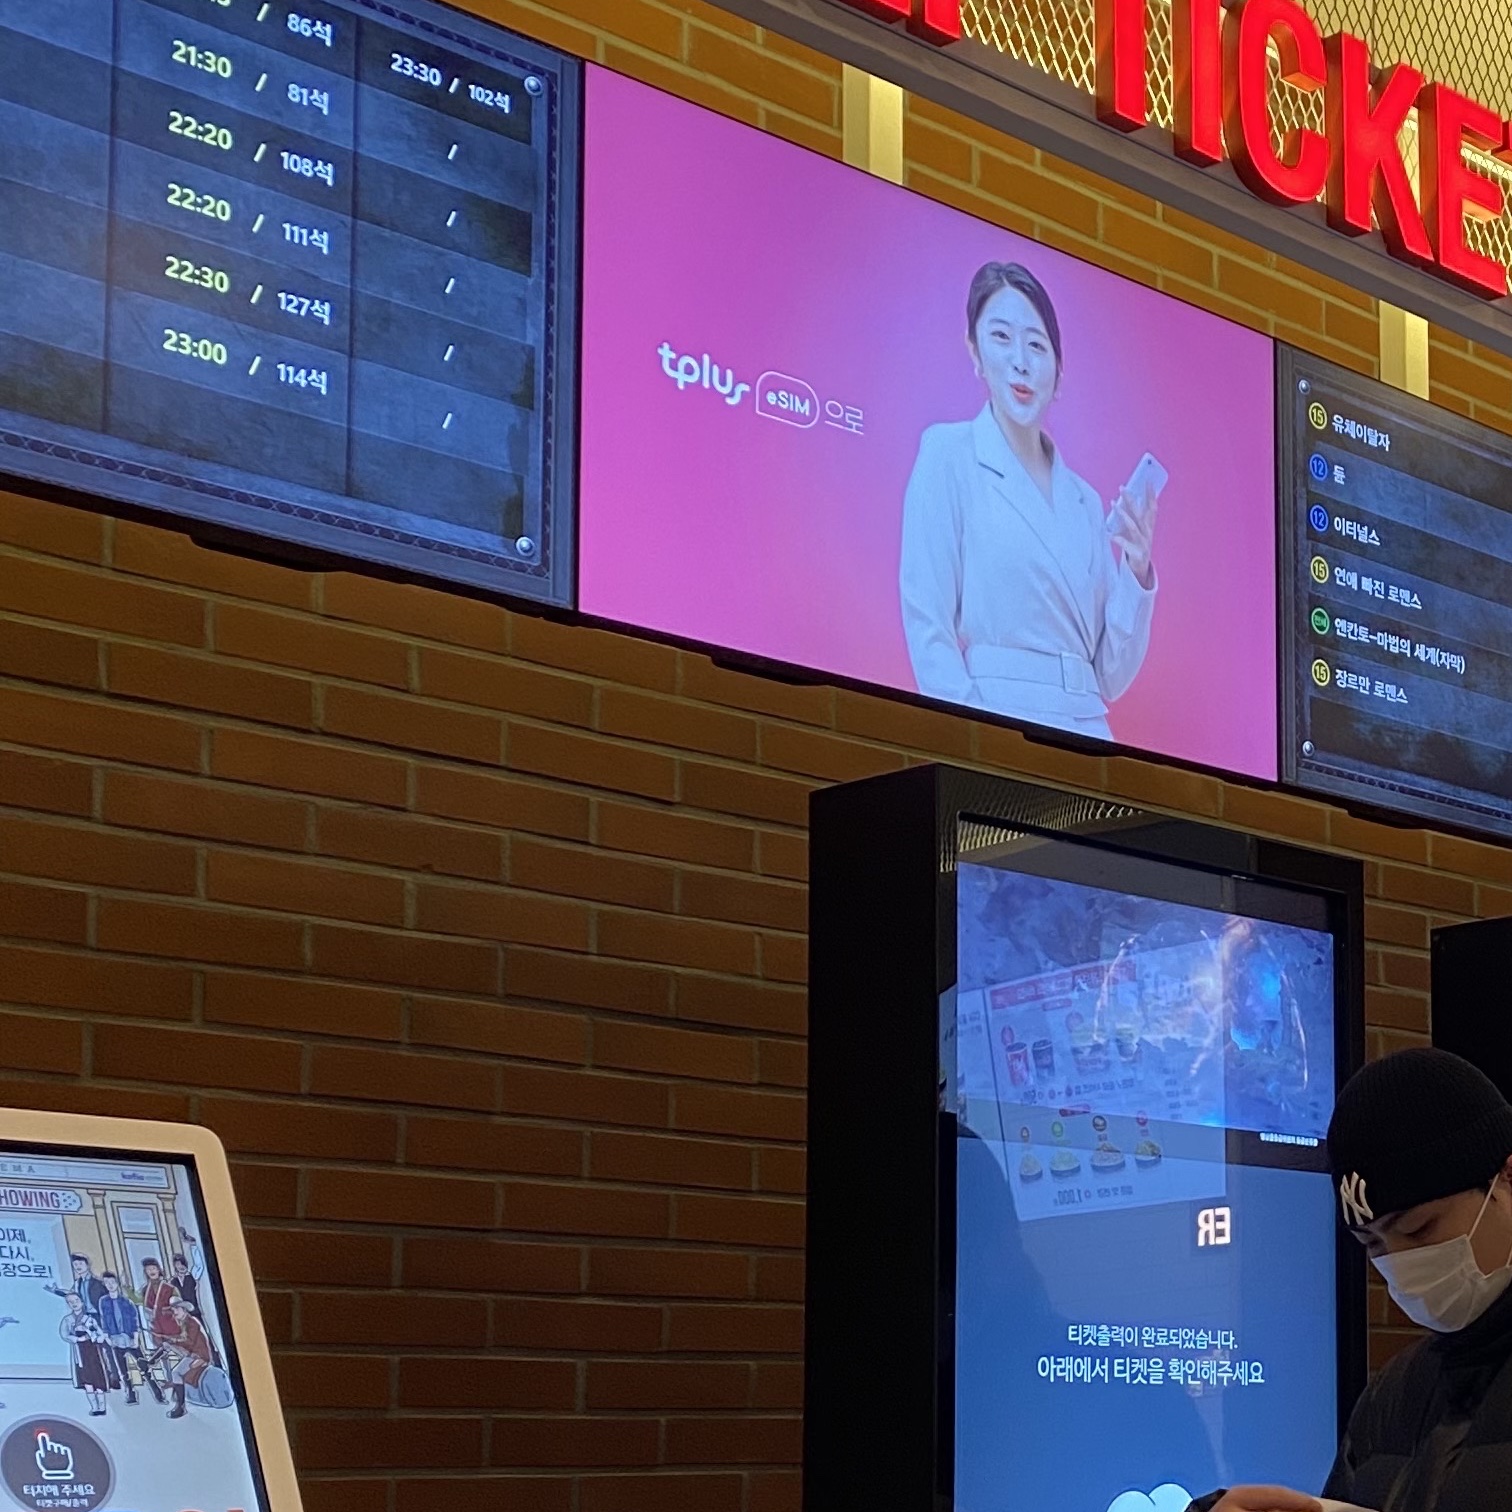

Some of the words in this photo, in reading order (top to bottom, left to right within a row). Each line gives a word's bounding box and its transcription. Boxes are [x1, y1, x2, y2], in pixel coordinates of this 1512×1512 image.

[286, 12, 333, 47] 86석
[171, 39, 232, 79] 21:30
[286, 82, 330, 116] 81석
[389, 53, 442, 87] 23:30
[467, 84, 511, 115] 102석
[168, 110, 233, 151] 22:20
[280, 151, 335, 187] 108석
[166, 183, 232, 222] 22:20
[281, 221, 330, 255] 111석
[164, 256, 230, 294] 22:30
[277, 291, 332, 326] 127석
[162, 328, 228, 365] 23:00
[276, 362, 328, 396] 114석
[657, 342, 751, 407] tplus
[766, 388, 811, 418] eSIM
[823, 400, 866, 437] 으로
[1332, 413, 1391, 452] 유체이탈자
[1332, 464, 1347, 486] 듄
[1333, 516, 1381, 547] 이터널스
[1334, 567, 1359, 592] 연애
[1361, 573, 1386, 601] 빠진
[1387, 582, 1423, 611] 로맨스
[1334, 617, 1412, 659] 엔칸토-마법의
[1413, 643, 1466, 675] 세계(자막)
[1334, 668, 1371, 695] 장르만
[1372, 680, 1409, 706] 로맨스
[1340, 1171, 1374, 1225] NY
[0, 1263, 52, 1280] 장으로!
[1067, 1323, 1138, 1348] 티켓출력이
[1141, 1326, 1239, 1350] 완료되었습니다.
[1037, 1356, 1110, 1384] 아래에서
[1113, 1357, 1164, 1385] 티켓을
[1167, 1358, 1266, 1387] 확인해주세요
[60, 1483, 96, 1496] 주세요
